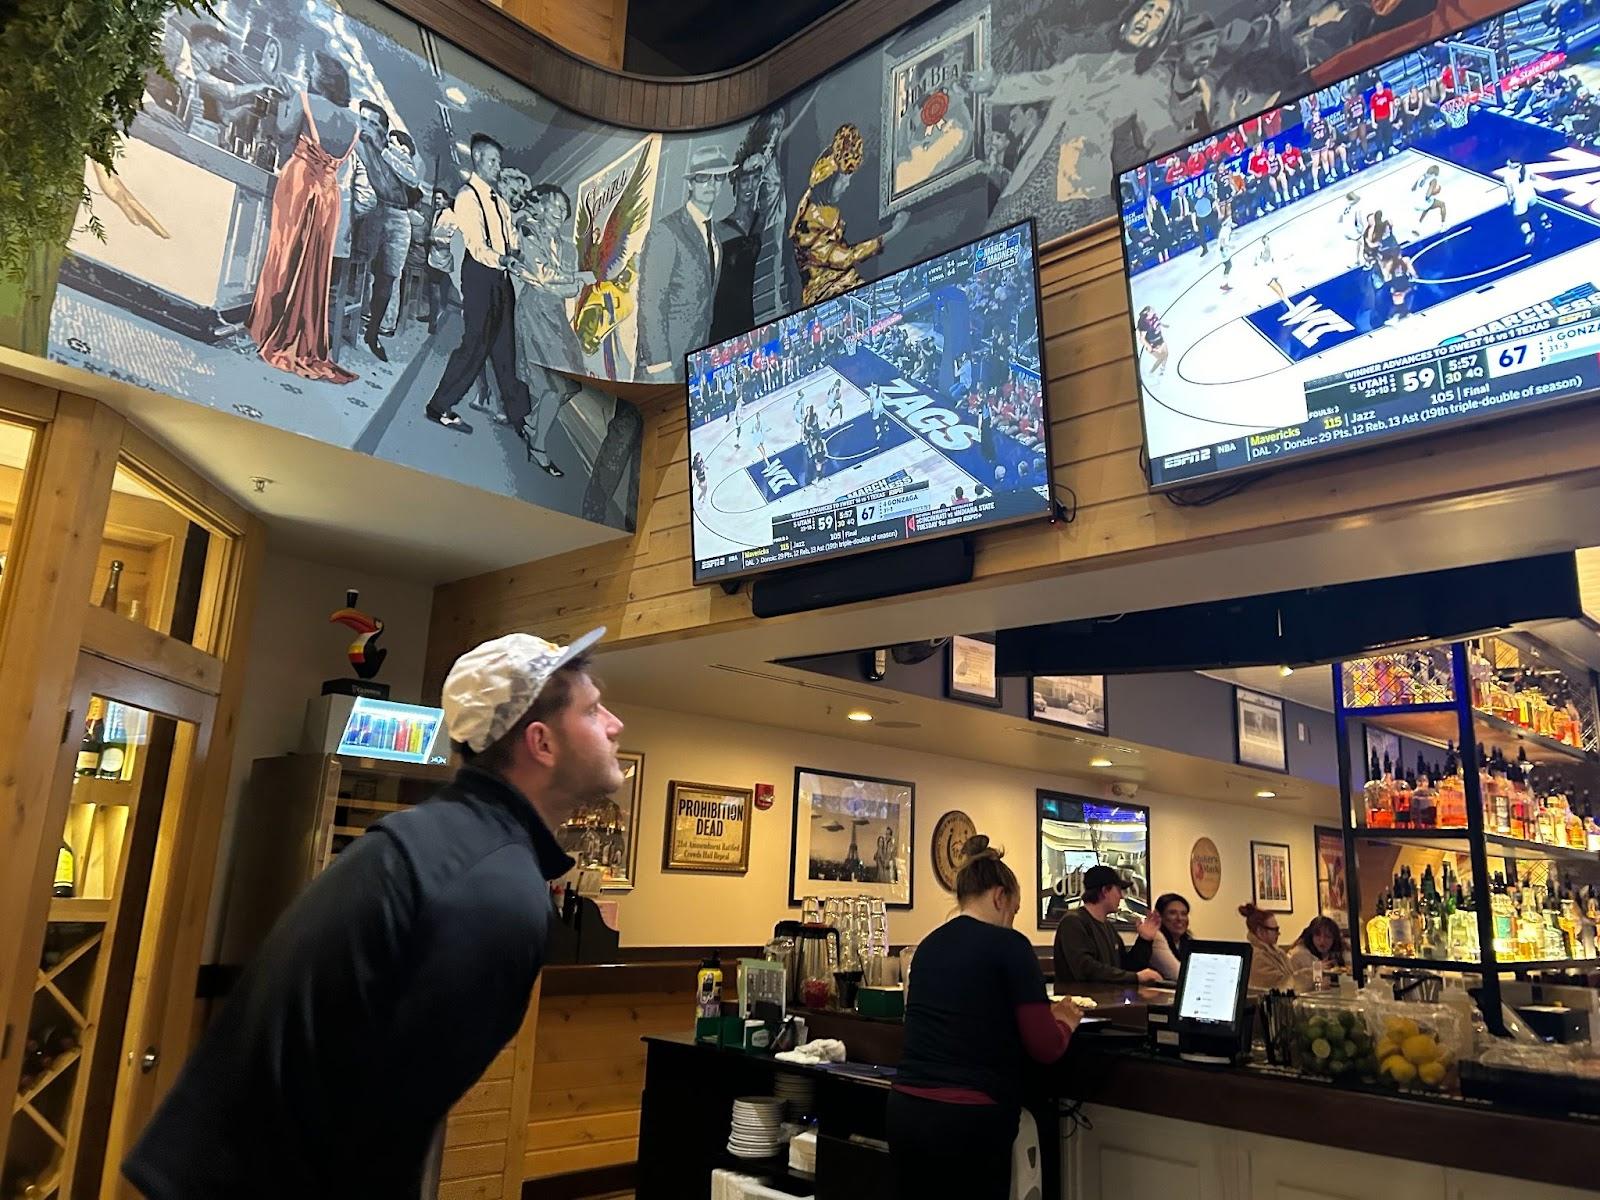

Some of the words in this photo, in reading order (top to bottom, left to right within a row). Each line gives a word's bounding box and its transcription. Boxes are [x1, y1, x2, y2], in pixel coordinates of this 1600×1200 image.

[931, 64, 960, 88] BEA
[984, 240, 1007, 258] MARCH
[987, 245, 1019, 266] MADNESS
[1465, 300, 1553, 338] MARCH
[1344, 364, 1382, 380] WINNER
[1383, 351, 1433, 370] ADVANCES
[1434, 347, 1447, 357] TO
[1449, 336, 1482, 352] SWEET
[1484, 334, 1495, 344] 16
[1516, 320, 1550, 335] TEXAS
[1558, 310, 1592, 326] ESPN
[1350, 383, 1357, 393] 5
[1357, 374, 1388, 391] UTAH
[1402, 367, 1436, 392] 59
[1448, 354, 1477, 371] 5:57
[1499, 345, 1527, 368] 67
[1557, 321, 1600, 341] GONZ
[1365, 385, 1389, 398] 23-10
[1445, 372, 1461, 384] 30
[1466, 367, 1484, 379] 4Q
[1549, 342, 1569, 353] 31-3
[878, 378, 981, 450] ZAGS
[1251, 427, 1301, 447] Mavericks
[1324, 416, 1343, 429] 115
[1350, 411, 1376, 424] Jazz
[1430, 391, 1454, 405] 105
[1463, 383, 1490, 398] Final
[1252, 447, 1271, 458] DAL
[1283, 438, 1317, 451] Doncic:
[1319, 433, 1332, 443] 29
[1353, 426, 1364, 436] 12
[1388, 416, 1400, 426] 13
[1401, 412, 1419, 424] Ast
[1421, 406, 1449, 421] (19th
[1450, 391, 1520, 413] triple-double
[1521, 385, 1534, 397] of
[1534, 376, 1583, 395] season)
[1218, 443, 1236, 454] NBA
[848, 480, 888, 499] MARCH
[818, 515, 833, 531] 59
[861, 507, 875, 520] 67
[888, 494, 918, 506] GONZAGA
[978, 502, 995, 511] STATE
[745, 548, 769, 559] Mavericks
[780, 543, 789, 551] 115
[830, 532, 841, 540] 105
[678, 799, 744, 822] PROHIBITION
[696, 819, 723, 836] DEAD
